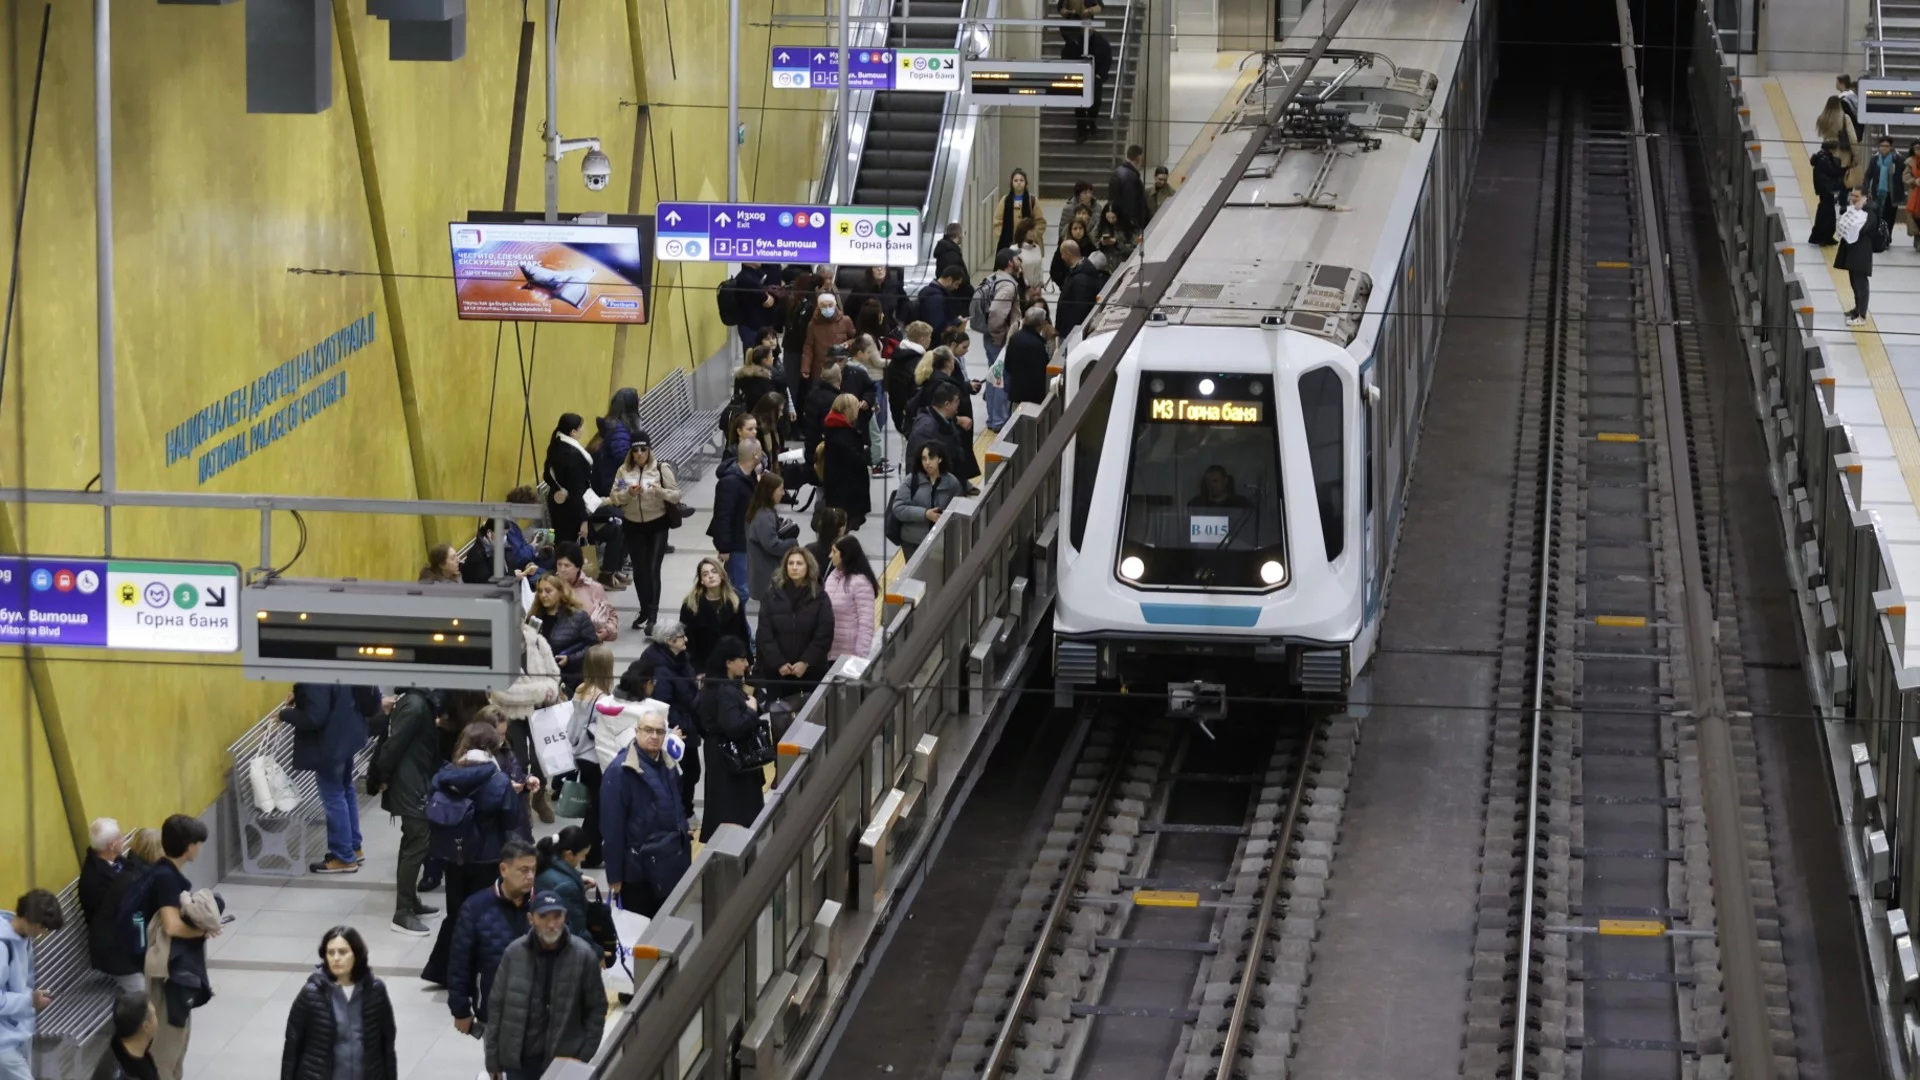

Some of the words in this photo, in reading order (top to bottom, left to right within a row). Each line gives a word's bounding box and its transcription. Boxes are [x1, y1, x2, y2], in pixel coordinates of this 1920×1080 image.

[858, 72, 887, 80] Витоша
[909, 71, 934, 80] Горна
[935, 71, 955, 80] баня
[737, 210, 766, 222] Изход
[737, 221, 750, 229] Exit
[756, 238, 775, 249] бул.
[777, 239, 817, 249] Витоша
[850, 239, 882, 250] Горна
[886, 240, 912, 251] баня
[497, 253, 534, 261] СПЕЧЕЛИ
[756, 249, 782, 257] Vitosha
[459, 259, 505, 267] ЕКСКУРЗИЯ
[165, 385, 247, 468] НАЦИОНАЛЕН
[249, 358, 297, 422] ДВОРЕЦ
[298, 349, 312, 387] НА
[313, 316, 367, 377] КУЛТУРАТА
[1152, 399, 1174, 419] М3
[1178, 400, 1221, 421] Горна
[1222, 402, 1258, 422] баня
[198, 431, 248, 486] NATIONAL
[250, 412, 287, 454] PALACE
[288, 398, 300, 431] OF
[301, 373, 339, 423] CULTURE
[1204, 524, 1228, 537] 015
[182, 591, 190, 601] 3
[0, 609, 25, 624] бул.
[29, 610, 88, 624] Витоша
[136, 612, 184, 628] Горна
[189, 613, 229, 628] баня
[38, 625, 60, 636] Blvd
[543, 731, 568, 745] BLS
